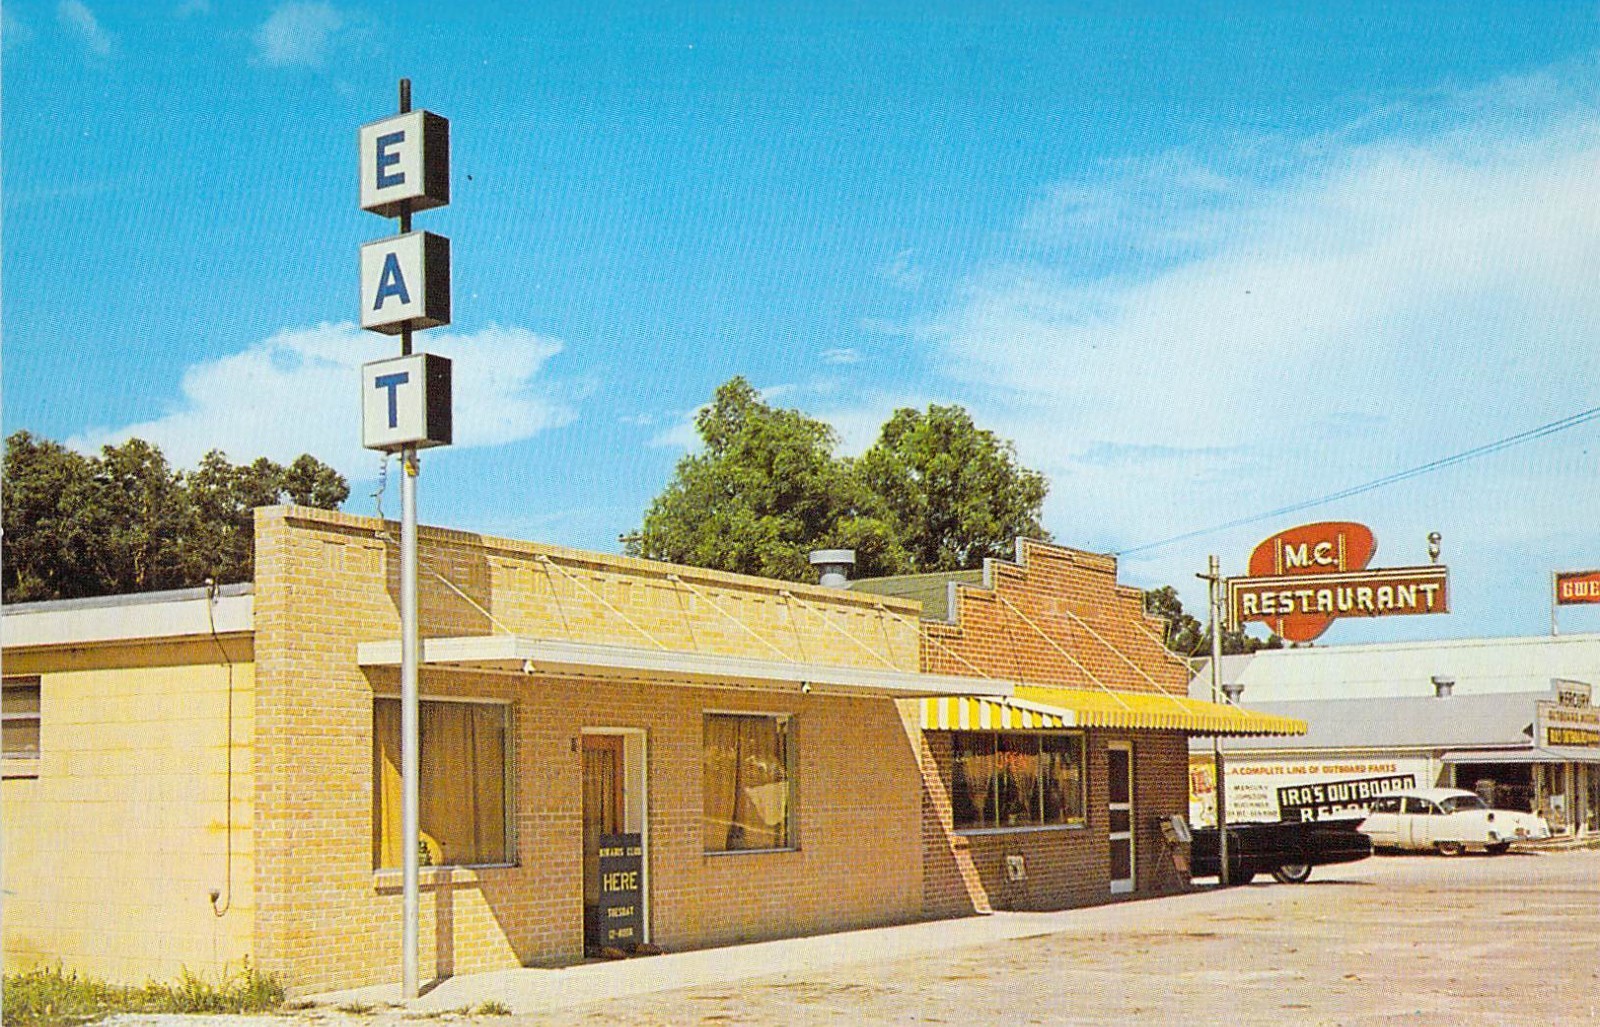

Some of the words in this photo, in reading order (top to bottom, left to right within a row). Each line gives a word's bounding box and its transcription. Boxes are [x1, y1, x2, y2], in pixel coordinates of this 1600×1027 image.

[373, 131, 411, 428] EAT
[1284, 541, 1339, 569] M.C.
[1242, 583, 1440, 615] RESTAURANT
[1240, 766, 1284, 776] COMPLETE
[1286, 765, 1307, 775] LINE
[1309, 765, 1320, 775] OF
[1322, 764, 1366, 774] OUTBOARD
[1368, 763, 1397, 773] PARTS
[1281, 785, 1325, 806] IRA'S
[1326, 777, 1414, 803] OUTBOARD
[603, 871, 638, 892] HERE
